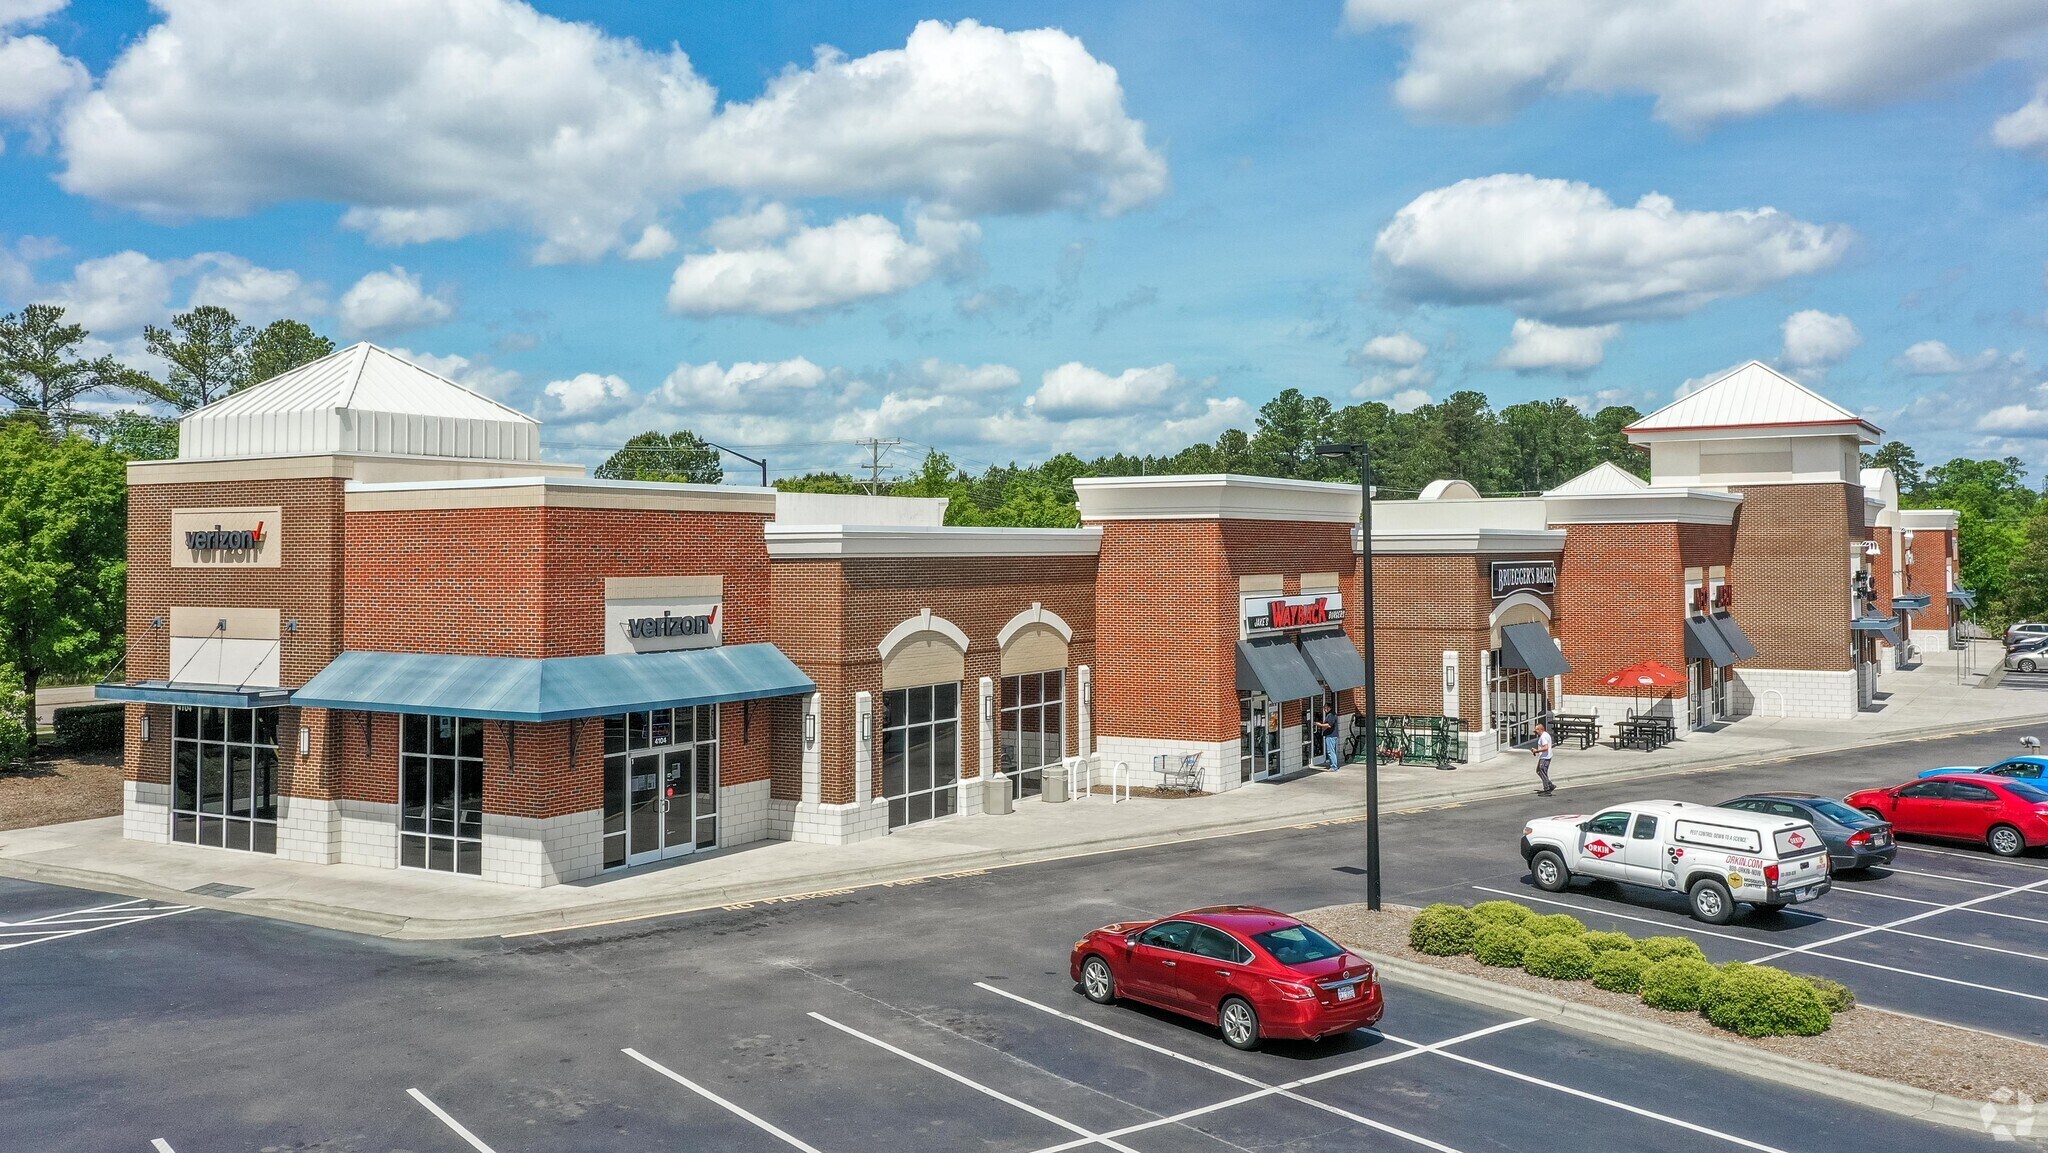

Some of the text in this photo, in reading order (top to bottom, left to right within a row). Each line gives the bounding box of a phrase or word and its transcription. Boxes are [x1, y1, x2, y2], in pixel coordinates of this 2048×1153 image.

[185, 524, 256, 550] verizon
[1497, 565, 1557, 592] BRUEGGER'S BAGELS
[1254, 616, 1269, 628] JAKE'S
[1267, 597, 1329, 629] WAYBACK
[628, 610, 709, 639] verizon
[654, 737, 667, 745] 4104
[1698, 830, 1713, 838] CONTROL
[1588, 843, 1610, 854] ORKIN
[1726, 855, 1763, 869] ORKIN.COM
